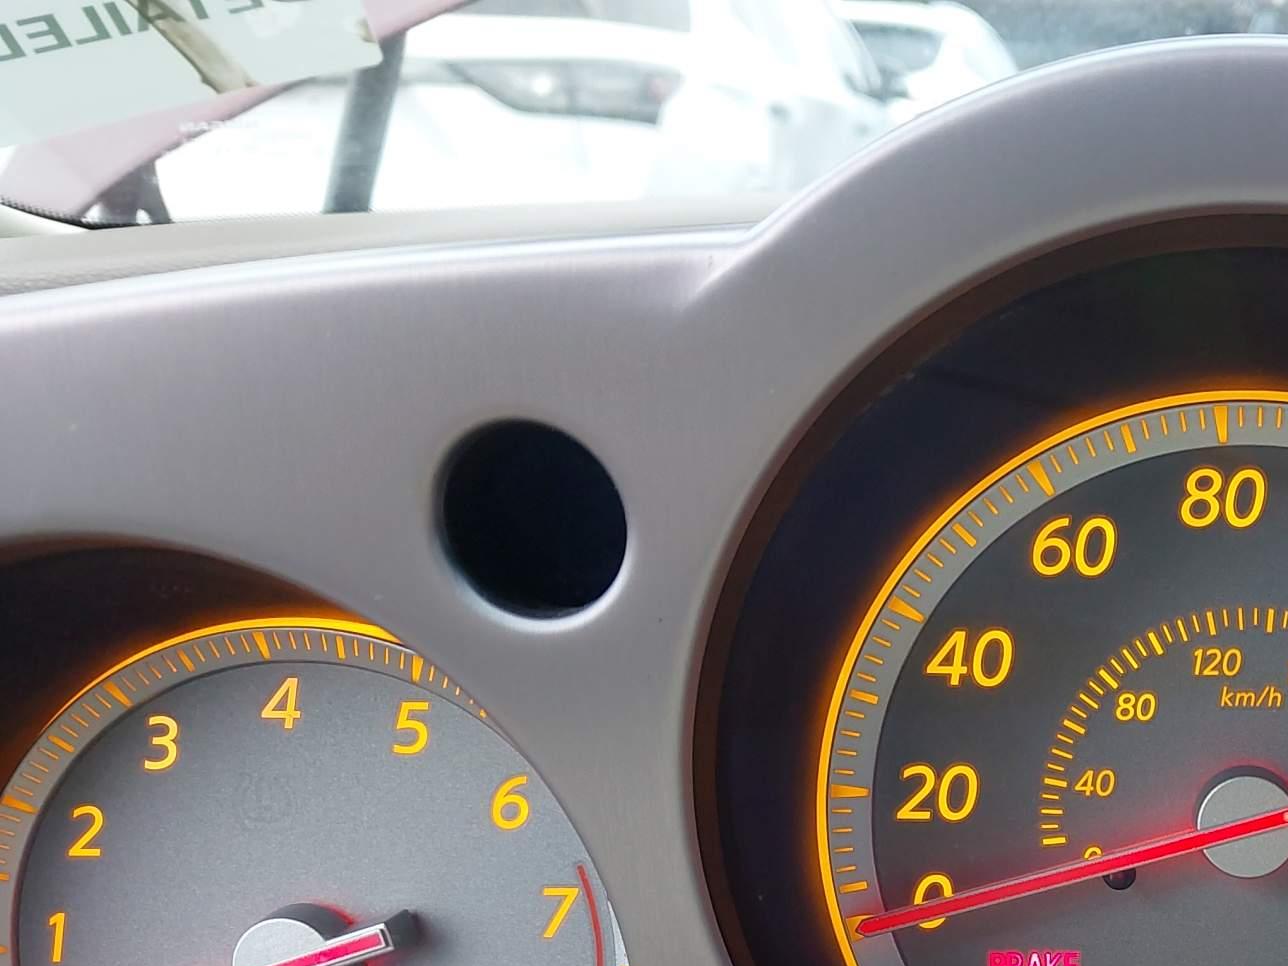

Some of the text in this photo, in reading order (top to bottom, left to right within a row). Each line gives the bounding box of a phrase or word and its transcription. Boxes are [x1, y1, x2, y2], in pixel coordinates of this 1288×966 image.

[1180, 468, 1265, 528] 80
[1032, 517, 1117, 577] 60
[926, 628, 1014, 688] 40
[1192, 648, 1242, 677] 120
[262, 677, 301, 730] 4
[1114, 690, 1156, 722] 80
[1220, 686, 1284, 709] km/h
[143, 715, 179, 772] 3
[392, 701, 430, 756] 5
[490, 775, 530, 831] 6
[896, 764, 978, 821] 20
[1073, 768, 1116, 798] 40
[67, 806, 105, 859] 2
[543, 886, 580, 939] 7
[913, 874, 956, 929] 0
[48, 912, 66, 964] 1
